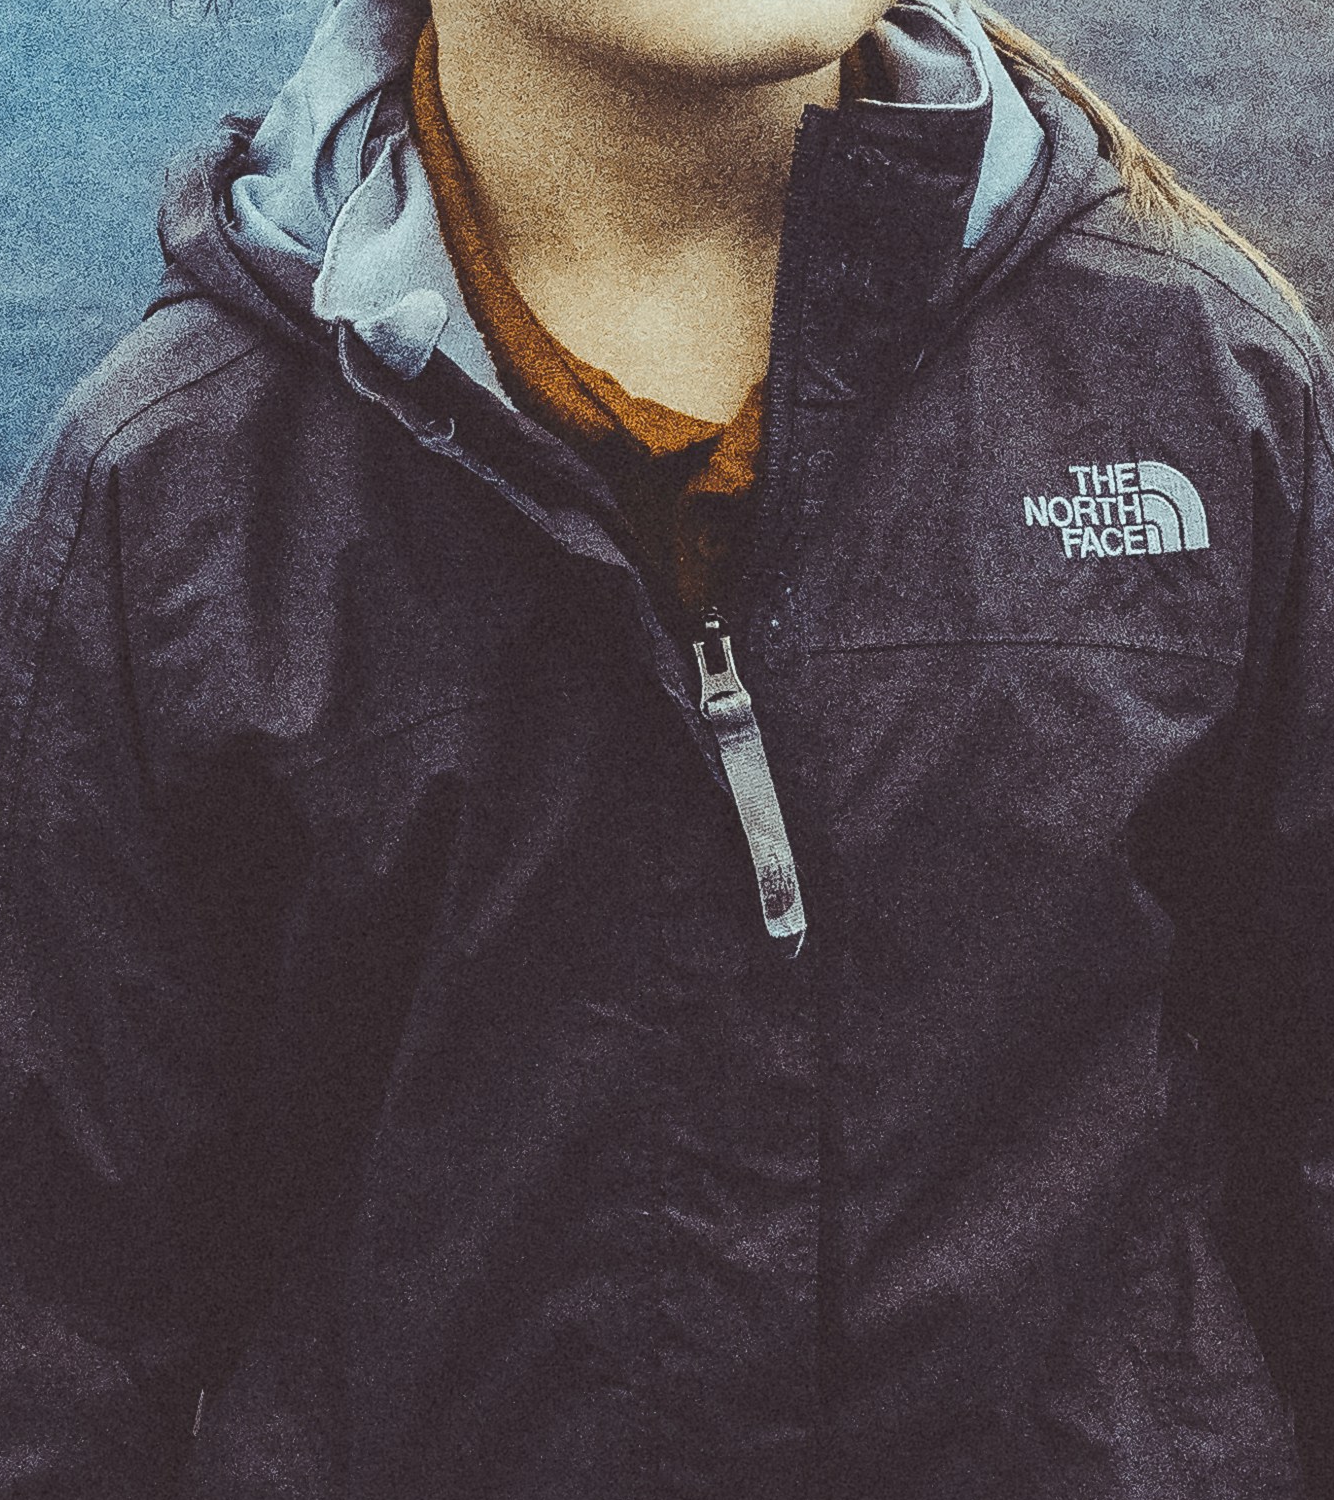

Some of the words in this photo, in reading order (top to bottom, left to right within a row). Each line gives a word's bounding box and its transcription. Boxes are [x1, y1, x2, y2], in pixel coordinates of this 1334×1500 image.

[1068, 462, 1140, 496] THE
[1023, 493, 1143, 527] NORTH
[1061, 524, 1147, 559] FACE
